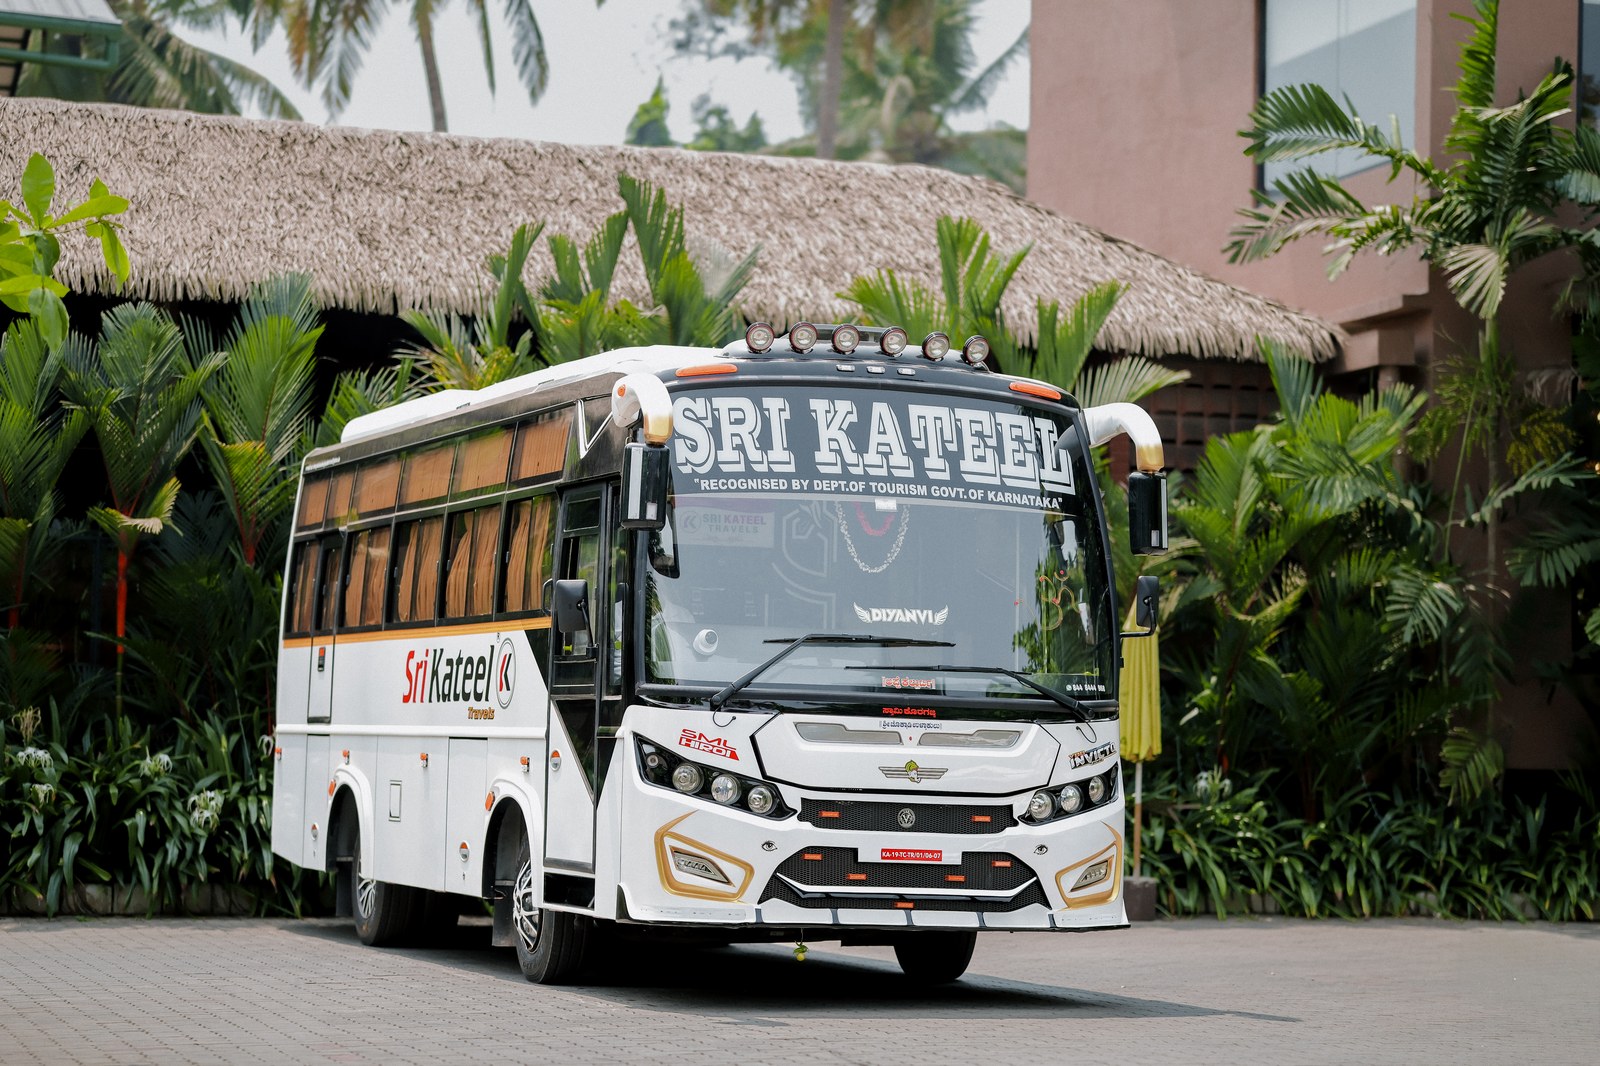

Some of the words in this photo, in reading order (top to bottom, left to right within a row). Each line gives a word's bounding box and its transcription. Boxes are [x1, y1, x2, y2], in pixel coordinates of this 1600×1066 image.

[672, 396, 796, 475] SRI
[809, 398, 1076, 496] KATEEL
[791, 479, 809, 491] BY
[869, 482, 928, 496] TOURISM
[702, 513, 721, 524] SRI
[723, 514, 767, 526] KATEEL
[708, 524, 758, 534] TRAVELS
[869, 607, 934, 626] DIYANVI
[402, 648, 429, 704] Sri
[428, 644, 495, 704] Kateel
[467, 707, 495, 720] Travels
[681, 728, 737, 751] SML
